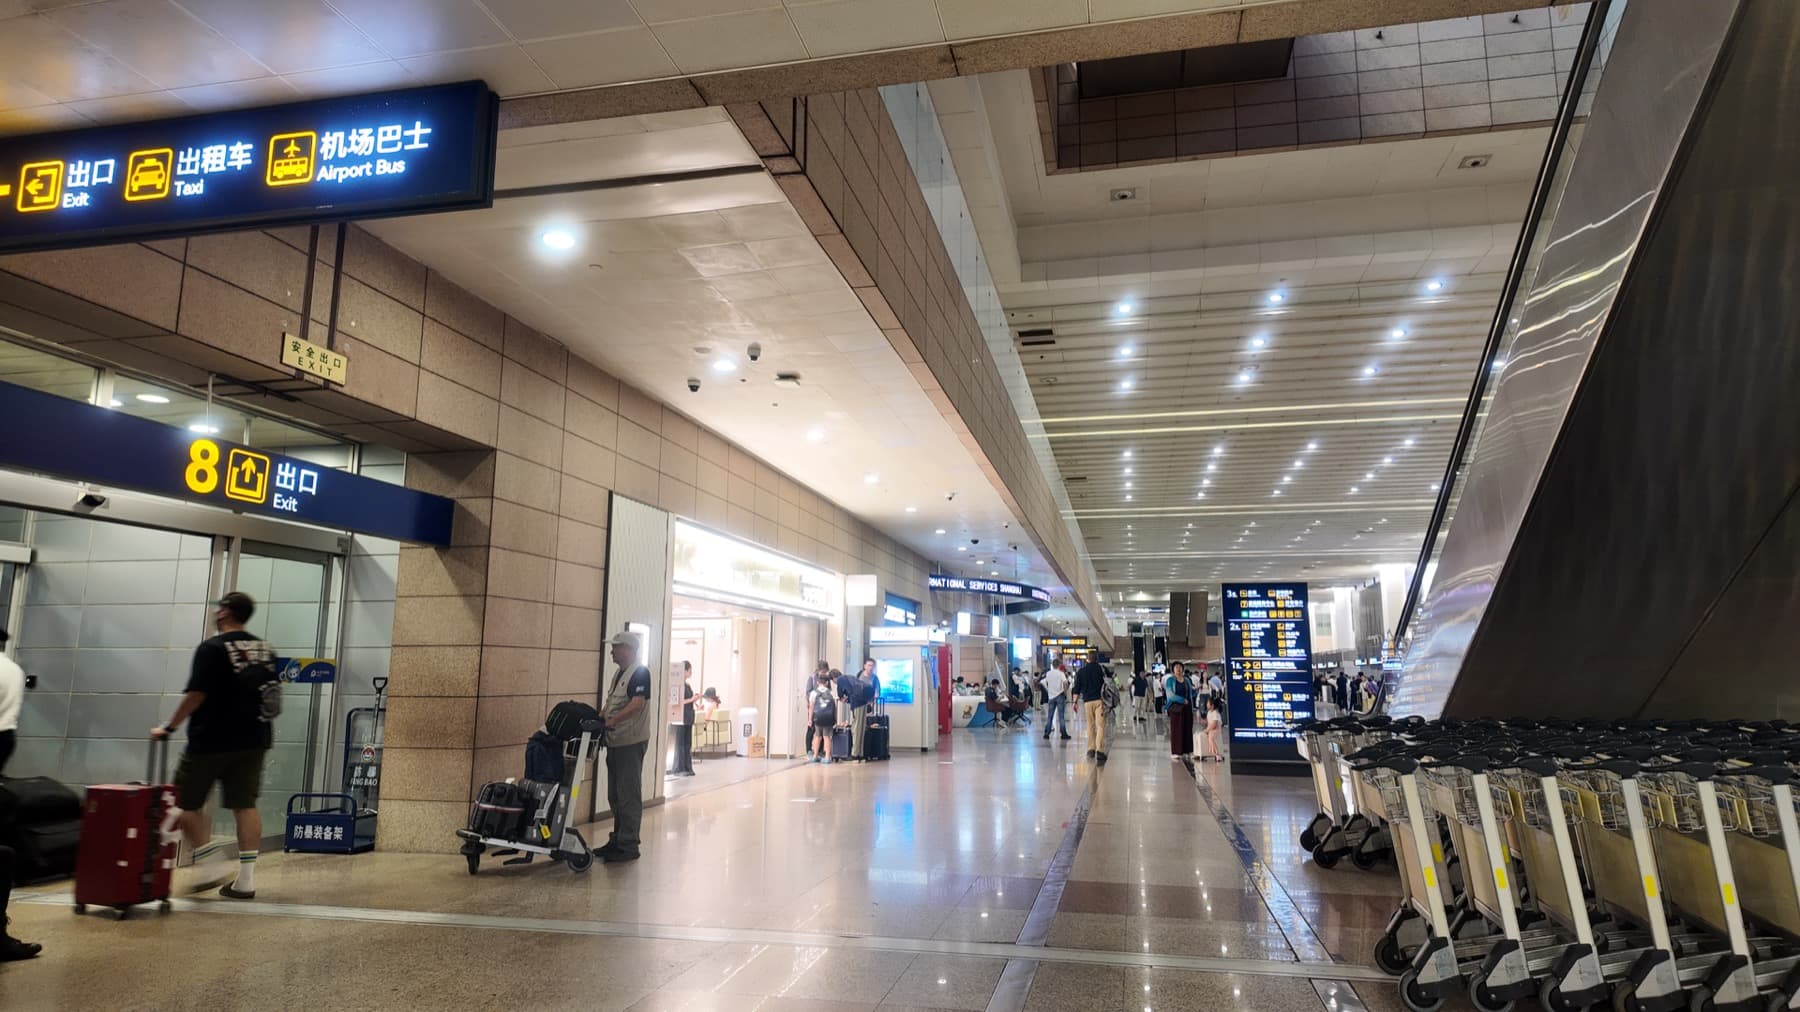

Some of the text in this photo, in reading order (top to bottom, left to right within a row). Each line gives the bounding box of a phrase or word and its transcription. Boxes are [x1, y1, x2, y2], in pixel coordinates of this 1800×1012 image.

[319, 120, 433, 161] 机场巴士
[176, 141, 254, 176] 出租车
[316, 158, 406, 184] Airport Bus
[67, 158, 116, 188] 出口
[62, 192, 91, 209] Exit
[174, 179, 205, 197] Taxi
[291, 340, 341, 369] 安全出口
[298, 356, 333, 377] EXIT
[185, 438, 220, 494] 8
[275, 462, 319, 496] 出口
[273, 493, 299, 512] Exit
[293, 824, 344, 841] 防暴装备架
